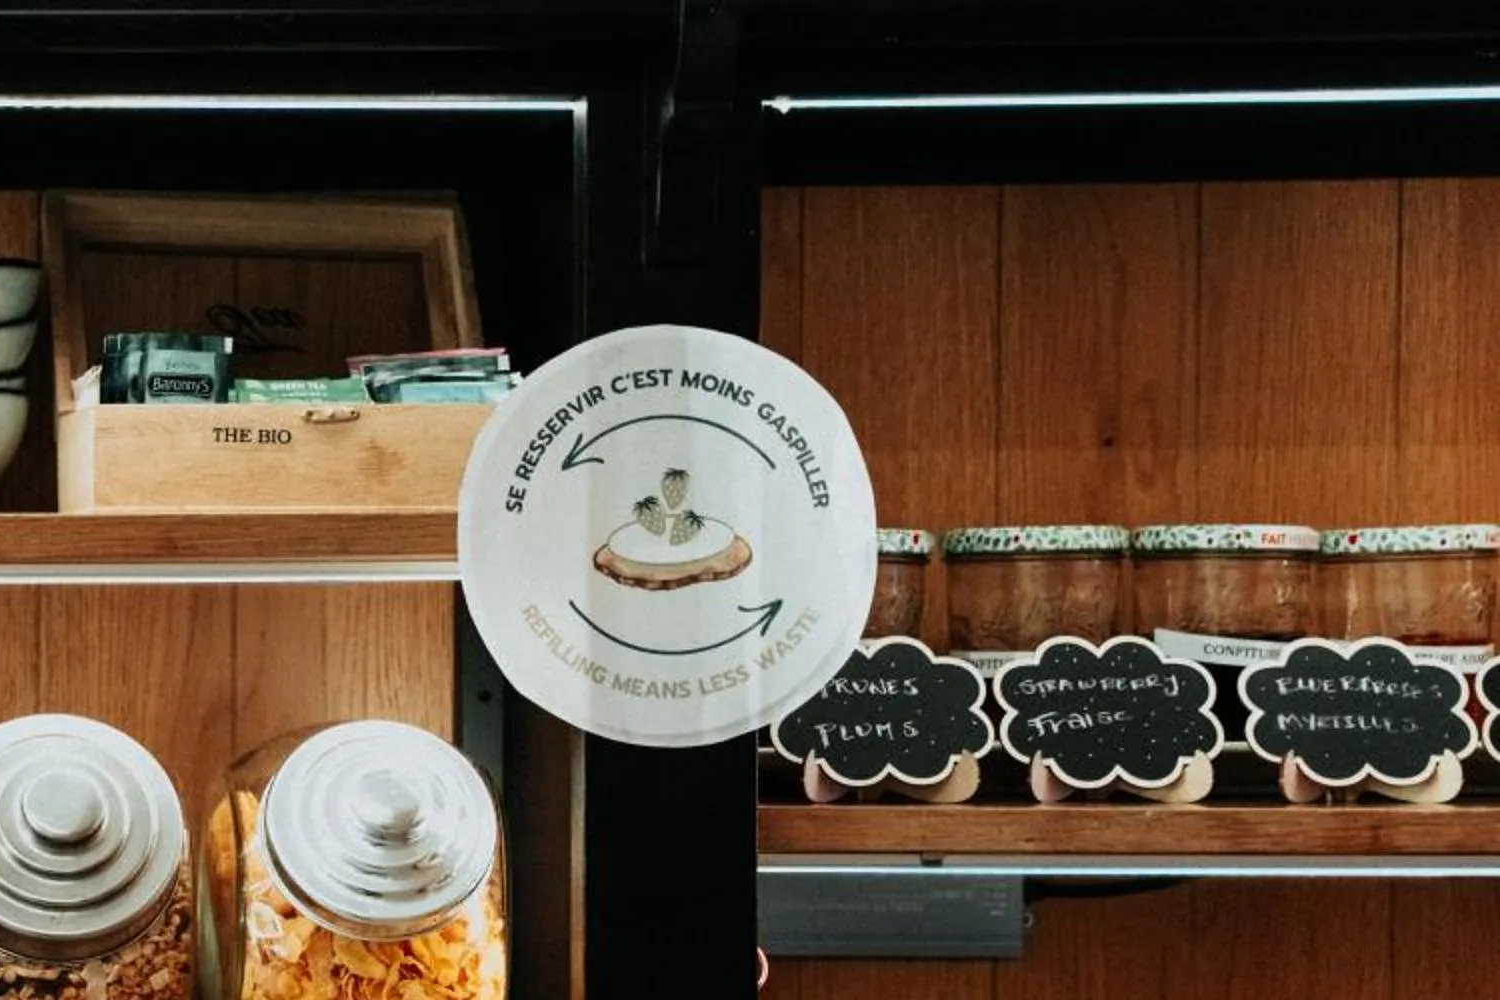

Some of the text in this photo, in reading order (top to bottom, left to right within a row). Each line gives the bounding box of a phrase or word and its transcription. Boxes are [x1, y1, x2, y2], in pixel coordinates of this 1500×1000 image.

[212, 427, 292, 445] THE BIO
[504, 369, 831, 515] SE RESSERVIR C'EST MOINS GASPILLER
[521, 604, 822, 699] REFILLING MEANS LESS WASTE
[814, 720, 920, 749] PLUMS
